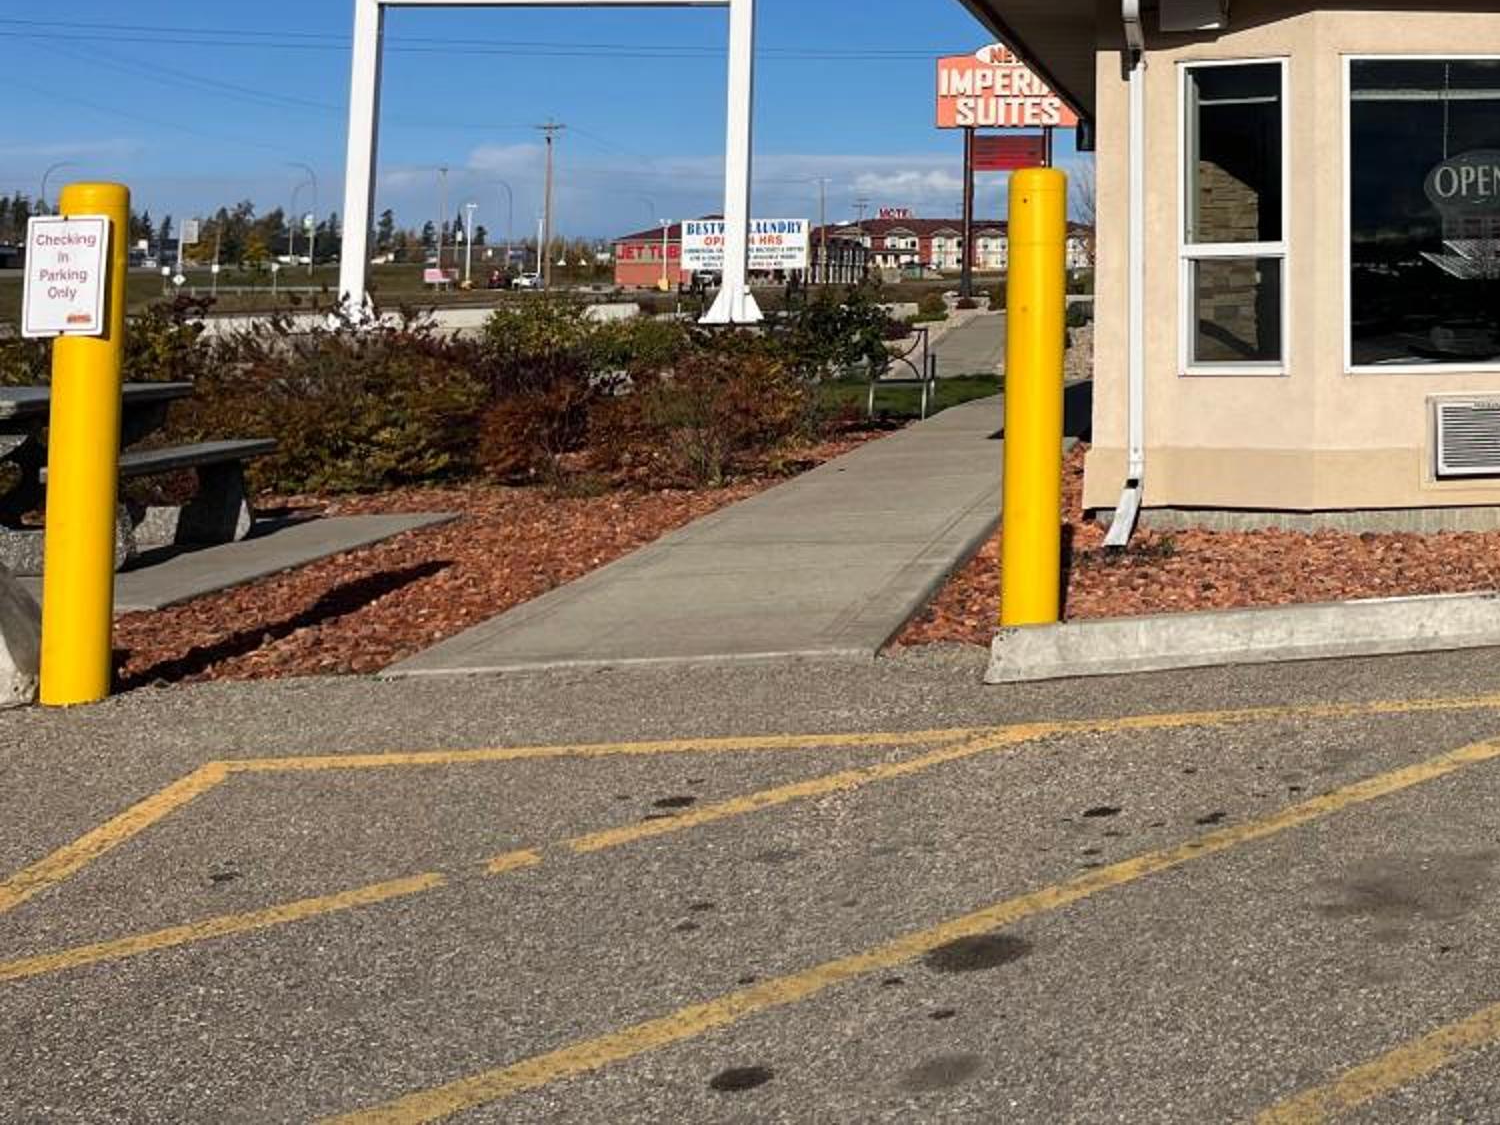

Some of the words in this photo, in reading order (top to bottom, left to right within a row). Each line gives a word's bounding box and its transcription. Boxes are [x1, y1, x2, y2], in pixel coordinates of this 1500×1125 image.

[989, 47, 1024, 64] NE
[956, 96, 1060, 126] SUITES
[36, 233, 97, 247] Checking
[759, 235, 783, 245] HRS
[39, 268, 88, 283] Parking
[47, 286, 77, 301] Only
